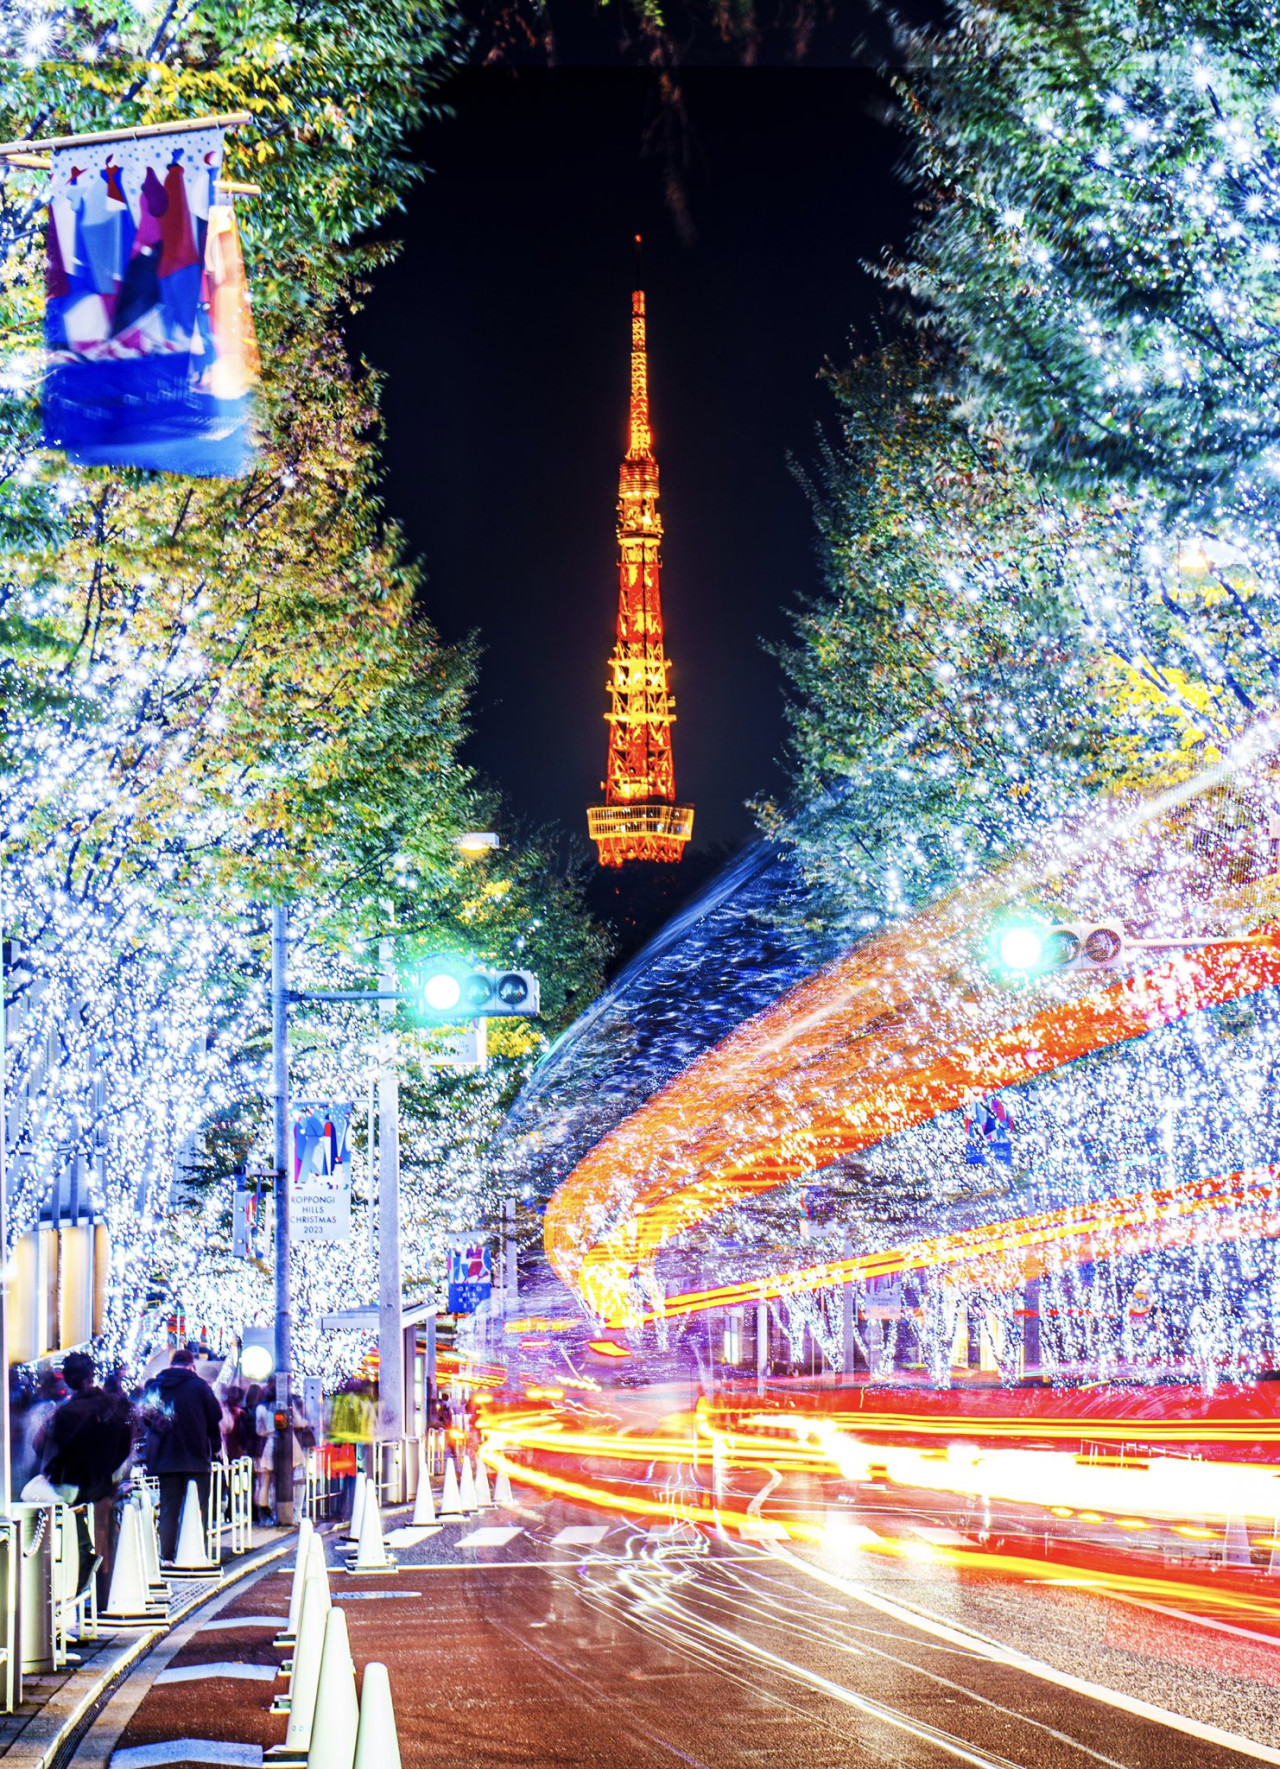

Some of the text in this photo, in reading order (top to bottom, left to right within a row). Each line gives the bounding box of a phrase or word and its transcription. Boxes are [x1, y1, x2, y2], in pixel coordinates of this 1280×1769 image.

[291, 1196, 336, 1204] ROPPONGI
[302, 1206, 325, 1214] HILLS
[290, 1216, 337, 1224] CHRISTMAS
[303, 1226, 324, 1235] 2023
